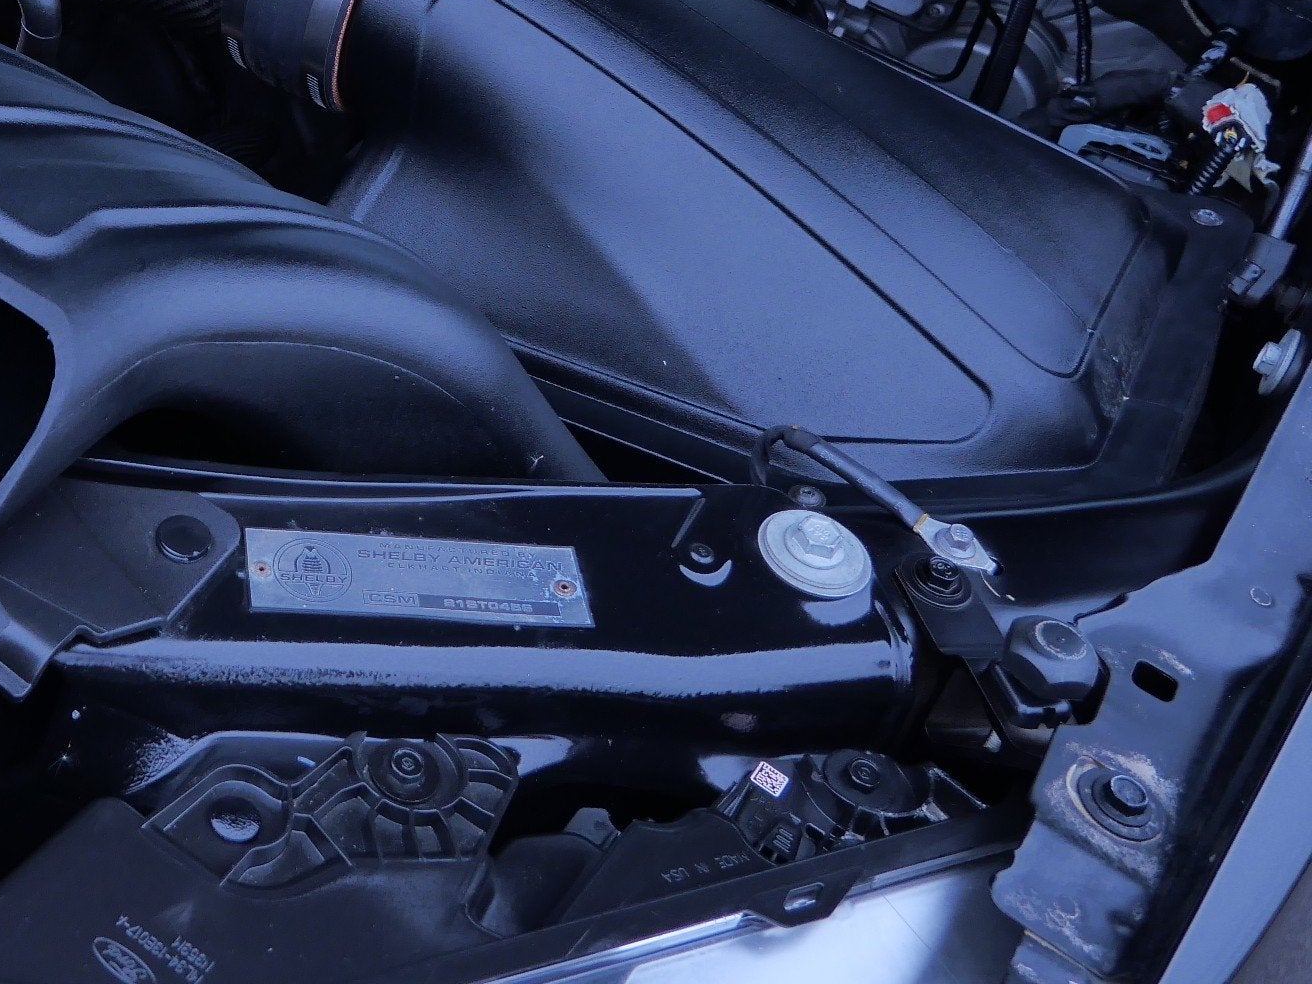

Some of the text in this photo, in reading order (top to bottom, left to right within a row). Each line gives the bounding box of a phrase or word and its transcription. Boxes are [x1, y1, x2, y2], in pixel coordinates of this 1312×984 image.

[379, 542, 536, 559] MANUFACTURED BY
[357, 549, 563, 571] SHELBY AMERICAN
[279, 572, 348, 584] SHELBY
[388, 562, 535, 578] ELKHART INDIANA
[368, 593, 418, 606] CSM
[661, 851, 751, 883] MADE IN USA
